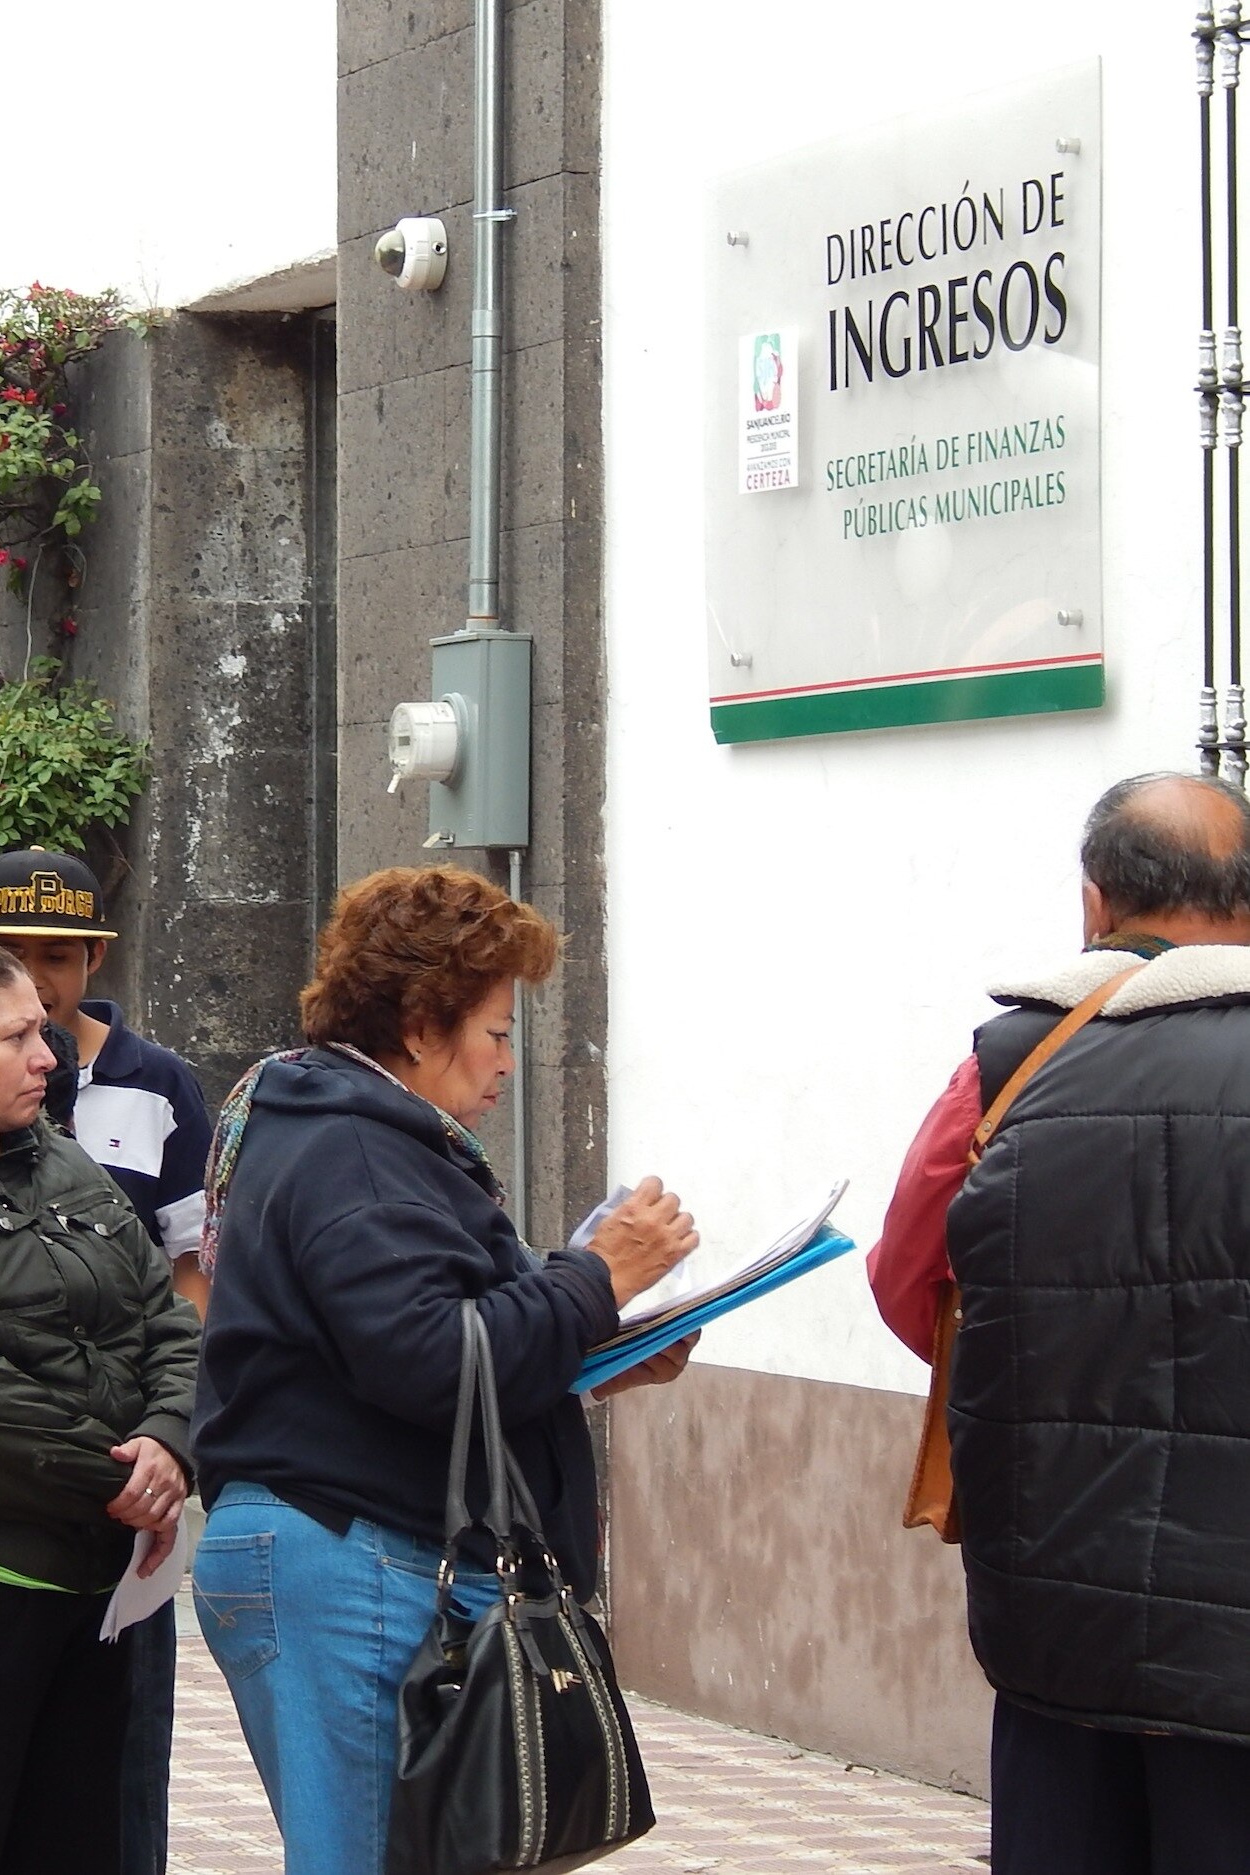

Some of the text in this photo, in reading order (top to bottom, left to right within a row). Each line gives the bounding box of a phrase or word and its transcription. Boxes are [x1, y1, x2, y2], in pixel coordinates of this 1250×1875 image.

[827, 172, 1064, 285] DIRECCIÓN DE
[829, 252, 1067, 391] INGRESOS
[747, 469, 790, 490] CERTEZA
[827, 415, 1065, 491] SECRETARÍA DE FINANZAS
[844, 471, 1066, 539] PÚBLICAS MUNICIPALES
